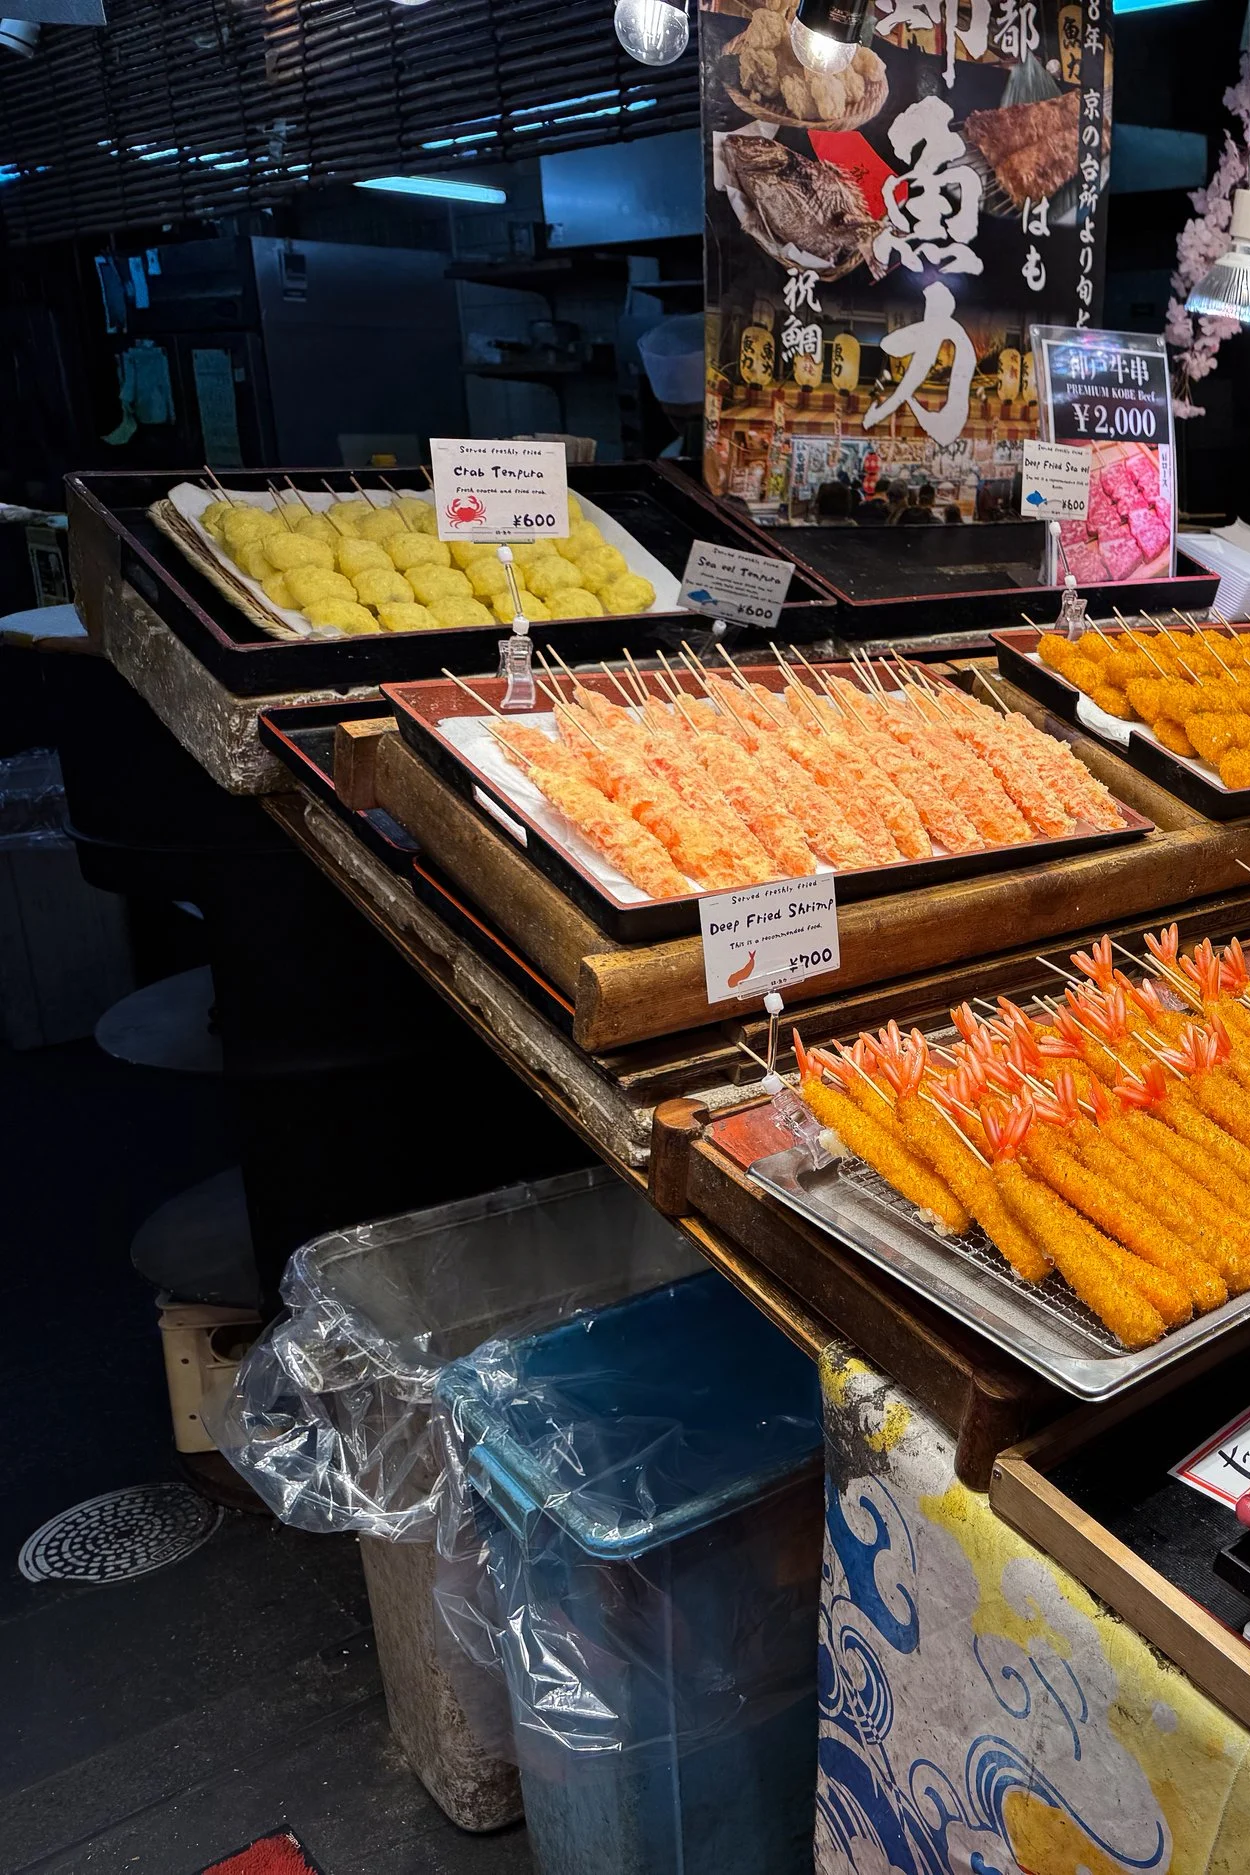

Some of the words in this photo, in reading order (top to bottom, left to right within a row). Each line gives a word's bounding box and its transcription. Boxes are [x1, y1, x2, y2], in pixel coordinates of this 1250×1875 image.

[1022, 196, 1050, 291] はも
[781, 267, 823, 363] 祝鯛
[1066, 382, 1110, 399] PREMIUM
[1111, 387, 1137, 400] KOBE
[1071, 402, 1157, 439] ¥2,000
[459, 445, 487, 454] Served
[491, 447, 519, 456] freshly
[453, 465, 485, 477] Crab
[490, 465, 544, 480] Tenpura
[1024, 457, 1041, 469] Deep
[1043, 460, 1062, 470] Fried
[1065, 461, 1078, 472] Sea
[1061, 499, 1085, 511] ¥600
[512, 513, 556, 528] ¥600
[697, 556, 717, 569] Sea
[737, 603, 773, 619] ¥600
[731, 892, 760, 905] Served
[764, 886, 794, 897] freshly
[797, 879, 818, 890] fried
[709, 919, 740, 936] Deep
[746, 909, 782, 928] Fried
[787, 898, 834, 918] Shrimp
[729, 942, 745, 950] This
[761, 928, 805, 942] recommended
[788, 947, 833, 974] ¥700
